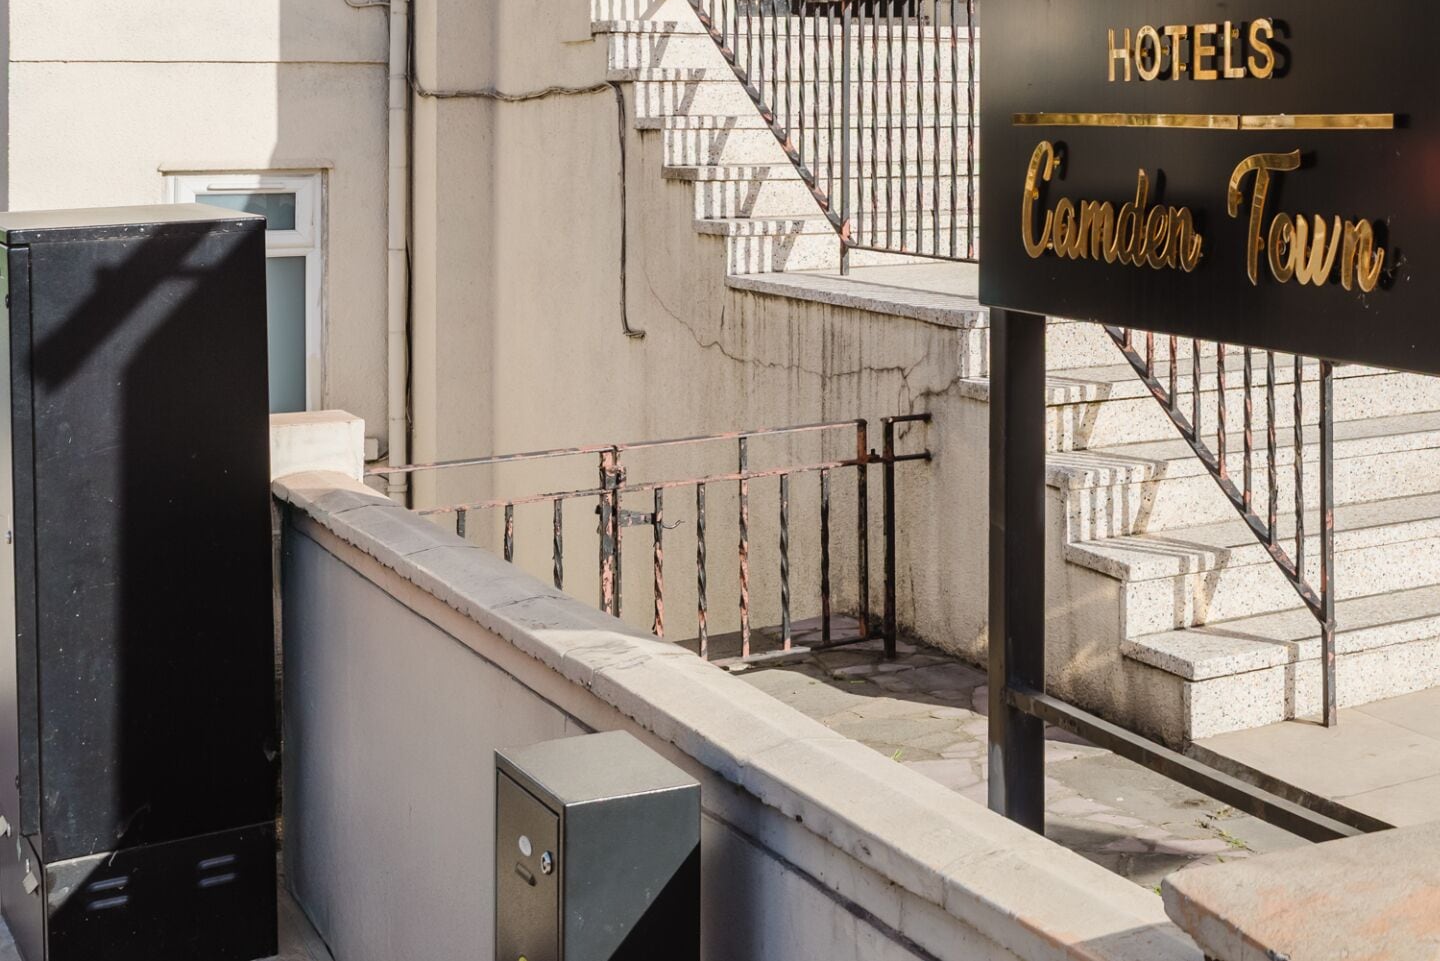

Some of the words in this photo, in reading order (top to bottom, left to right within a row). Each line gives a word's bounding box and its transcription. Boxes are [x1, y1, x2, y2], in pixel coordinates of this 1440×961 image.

[1107, 18, 1274, 82] HOTELS
[1021, 140, 1202, 272] Camden
[1227, 148, 1385, 292] Town
